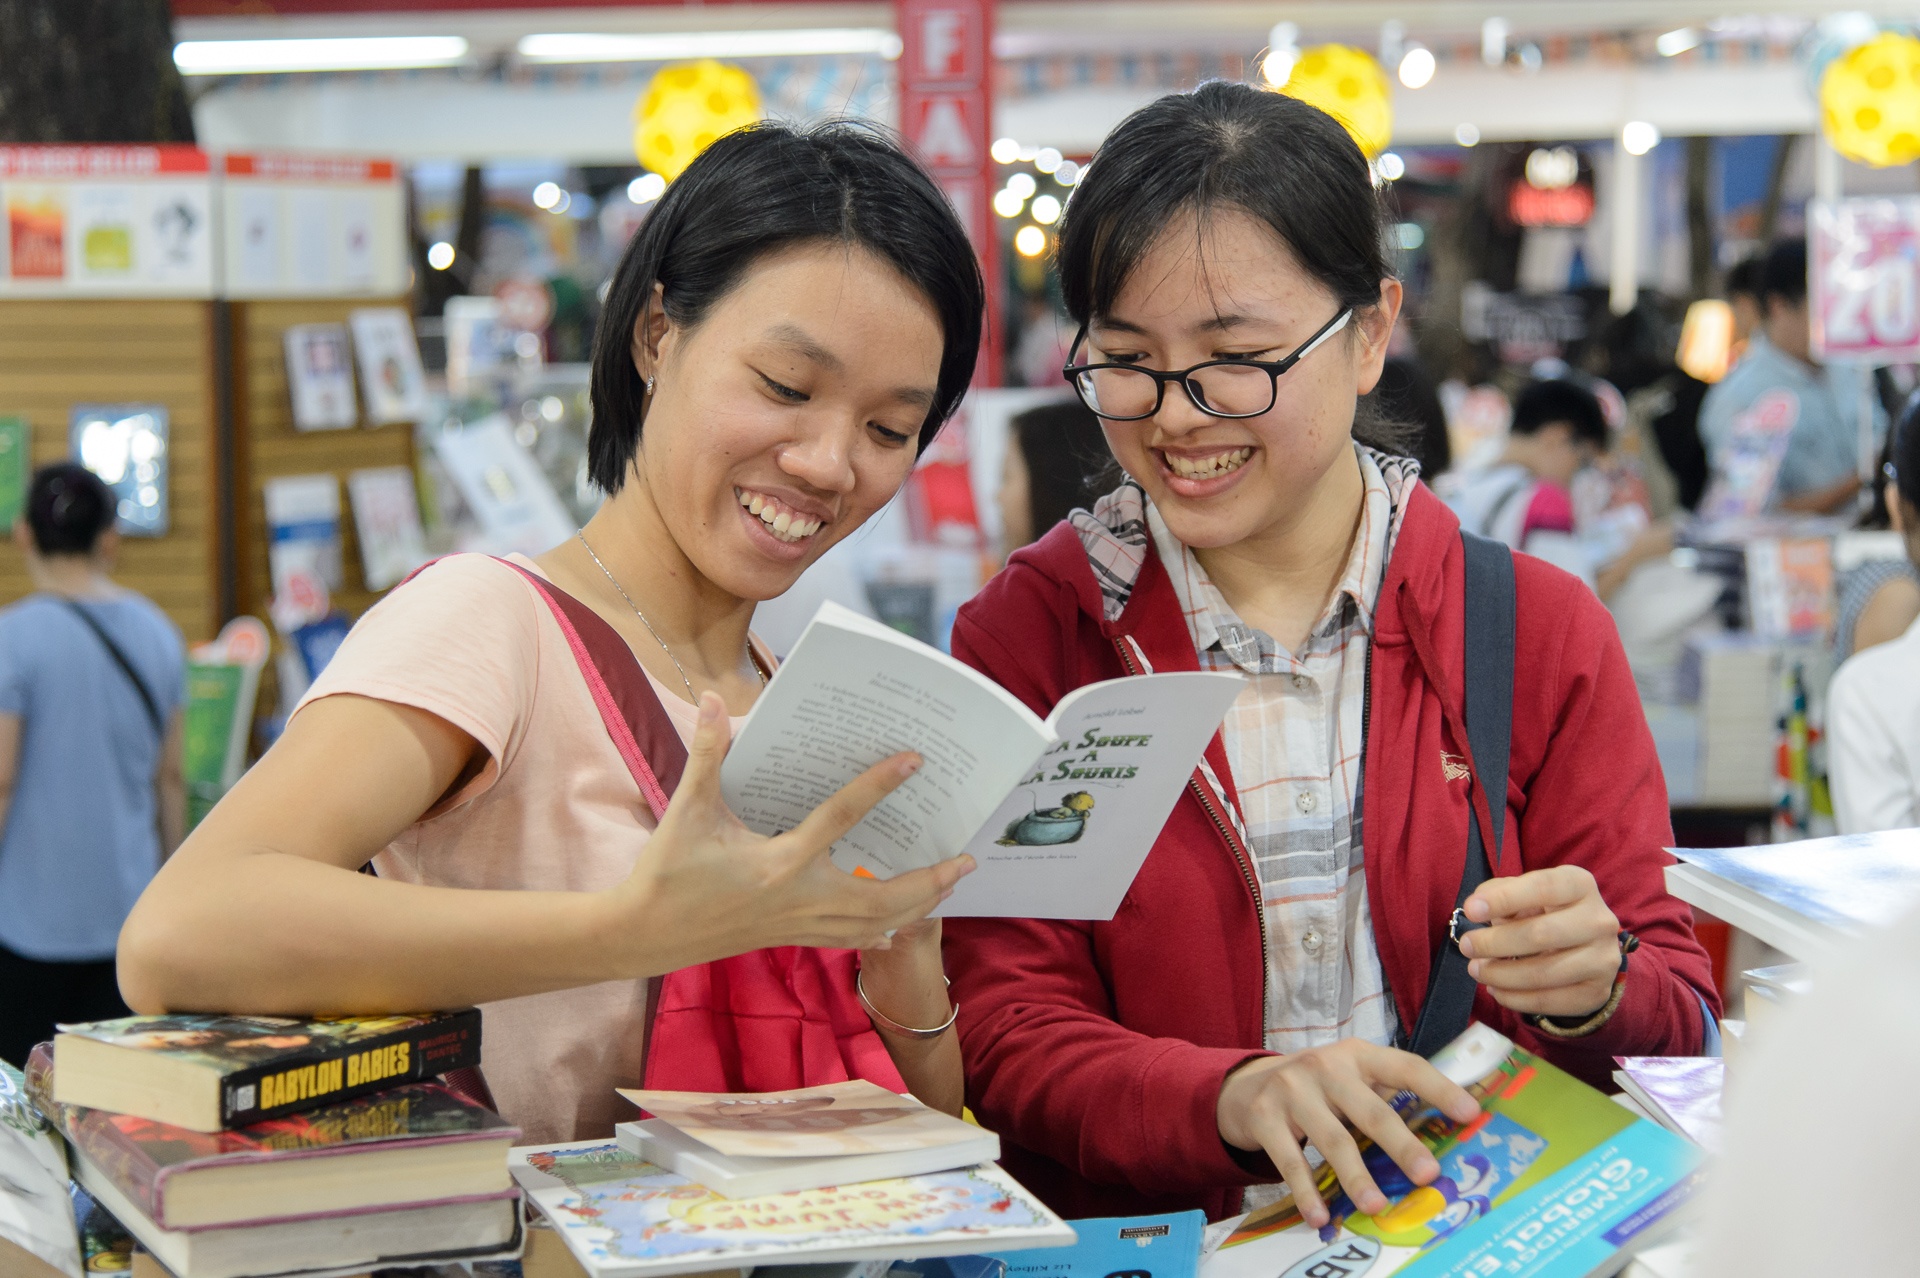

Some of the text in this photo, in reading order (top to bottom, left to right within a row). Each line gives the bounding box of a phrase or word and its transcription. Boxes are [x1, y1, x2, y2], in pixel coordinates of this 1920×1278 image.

[1076, 728, 1153, 750] SOUPE
[1050, 759, 1139, 781] SOURIS
[260, 1058, 344, 1111] BABYLON
[347, 1041, 411, 1088] BABIES
[1538, 1161, 1601, 1208] Cambridge
[1502, 1158, 1633, 1252] Global
[1505, 1167, 1649, 1275] CAMBRIDGE
[640, 1208, 854, 1243] Jumped
[1493, 1206, 1539, 1242] Primary
[1005, 1263, 1072, 1273] Liz Kilbey
